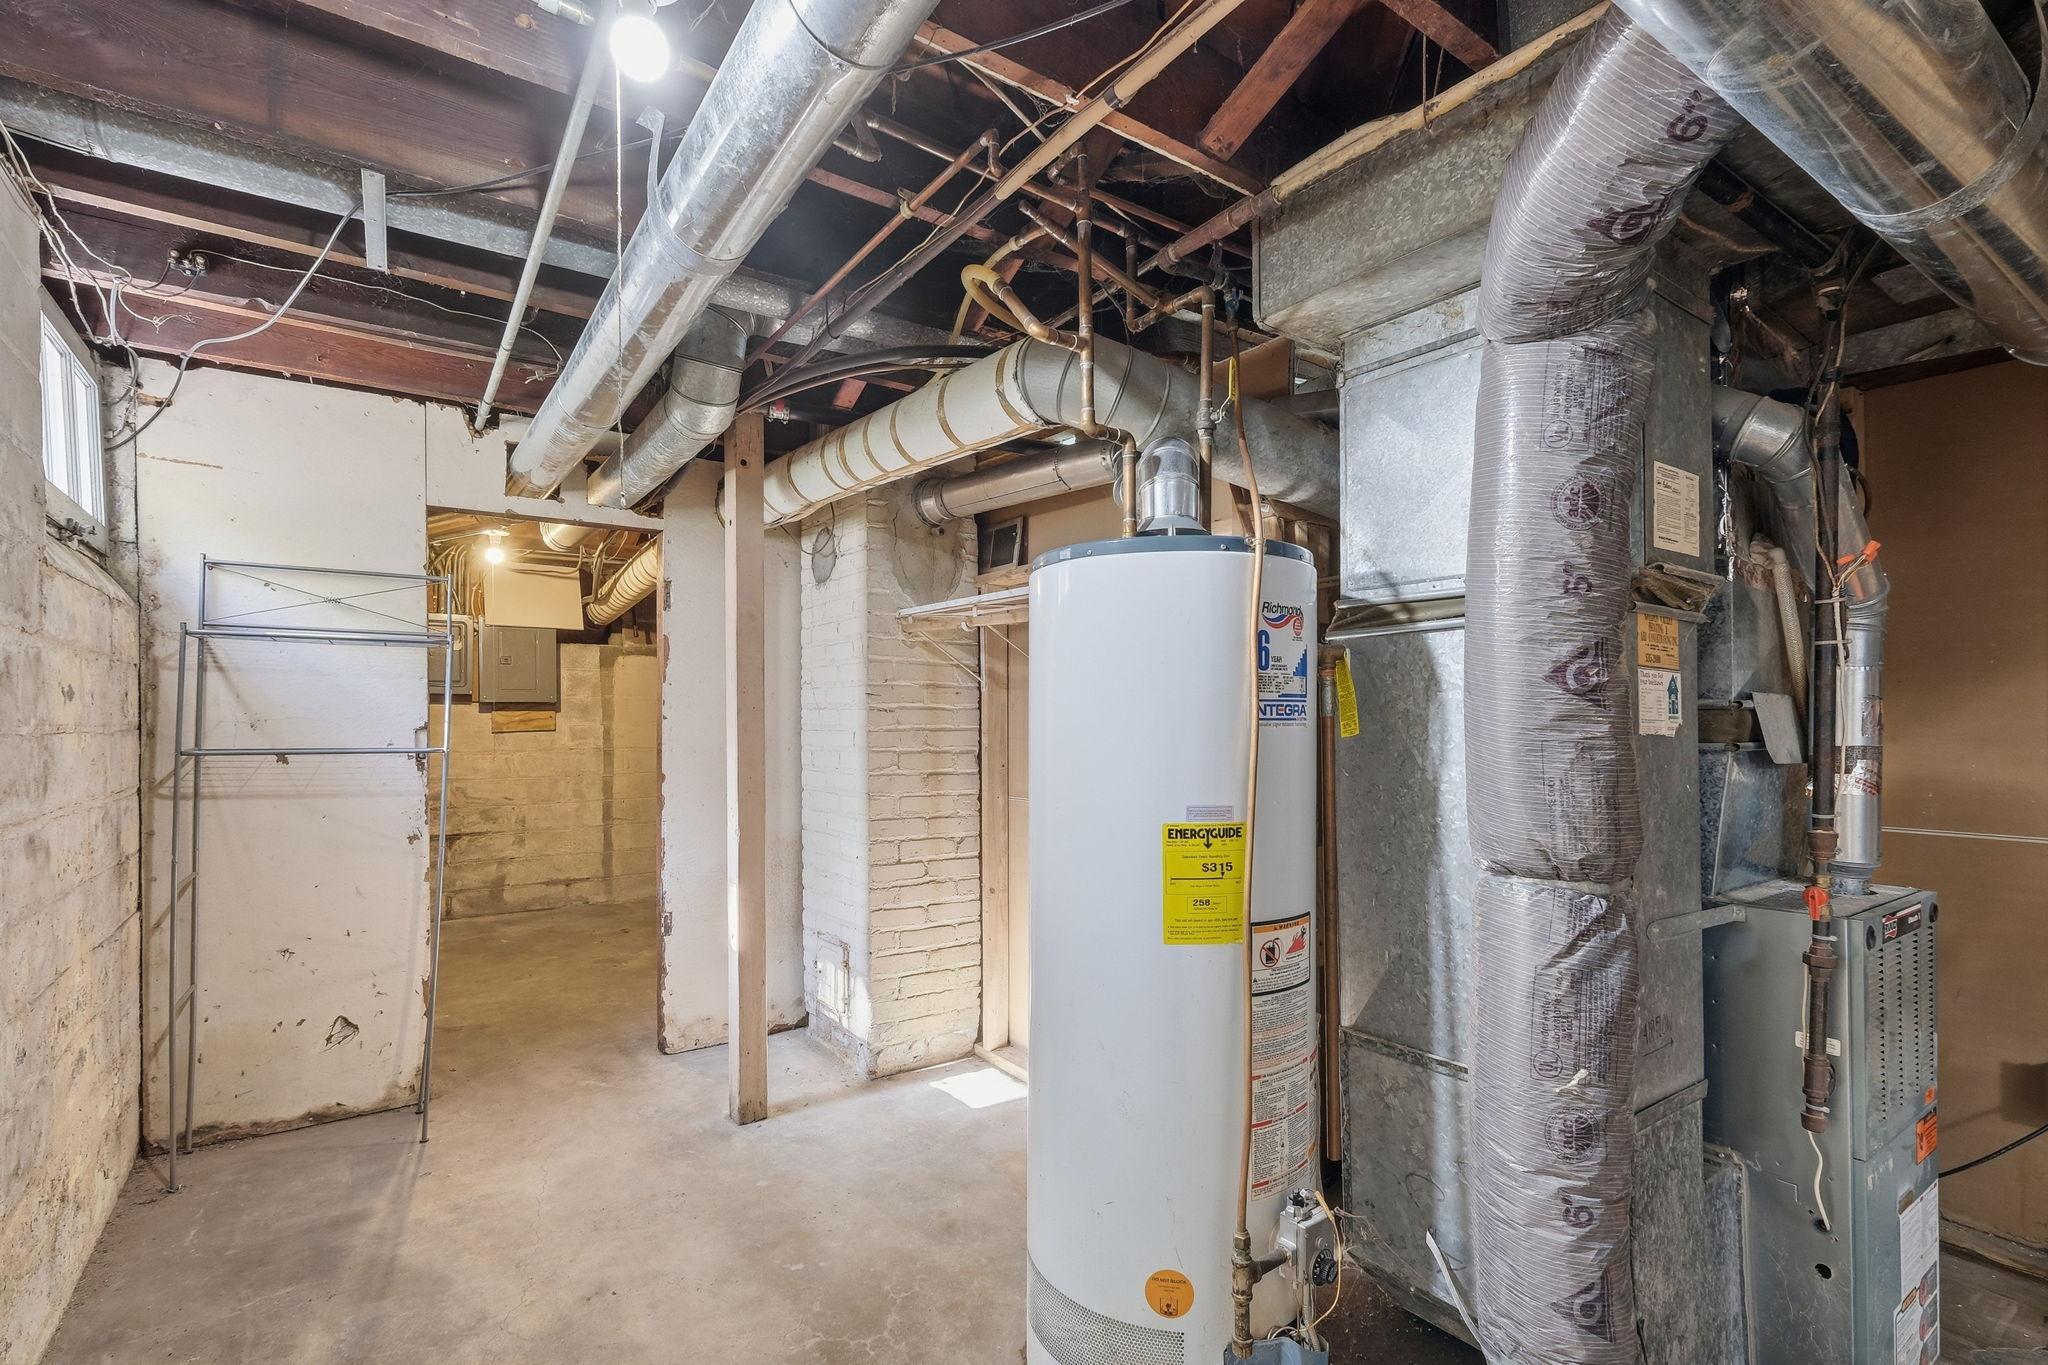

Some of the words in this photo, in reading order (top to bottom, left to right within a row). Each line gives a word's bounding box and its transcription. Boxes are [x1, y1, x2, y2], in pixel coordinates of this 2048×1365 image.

[1262, 601, 1303, 617] Richmond
[1258, 630, 1270, 671] 6
[1258, 704, 1306, 716] NTEGRA
[1168, 827, 1242, 840] ENERGYGUIDE
[1202, 862, 1233, 872] $315
[1193, 899, 1211, 907] 258
